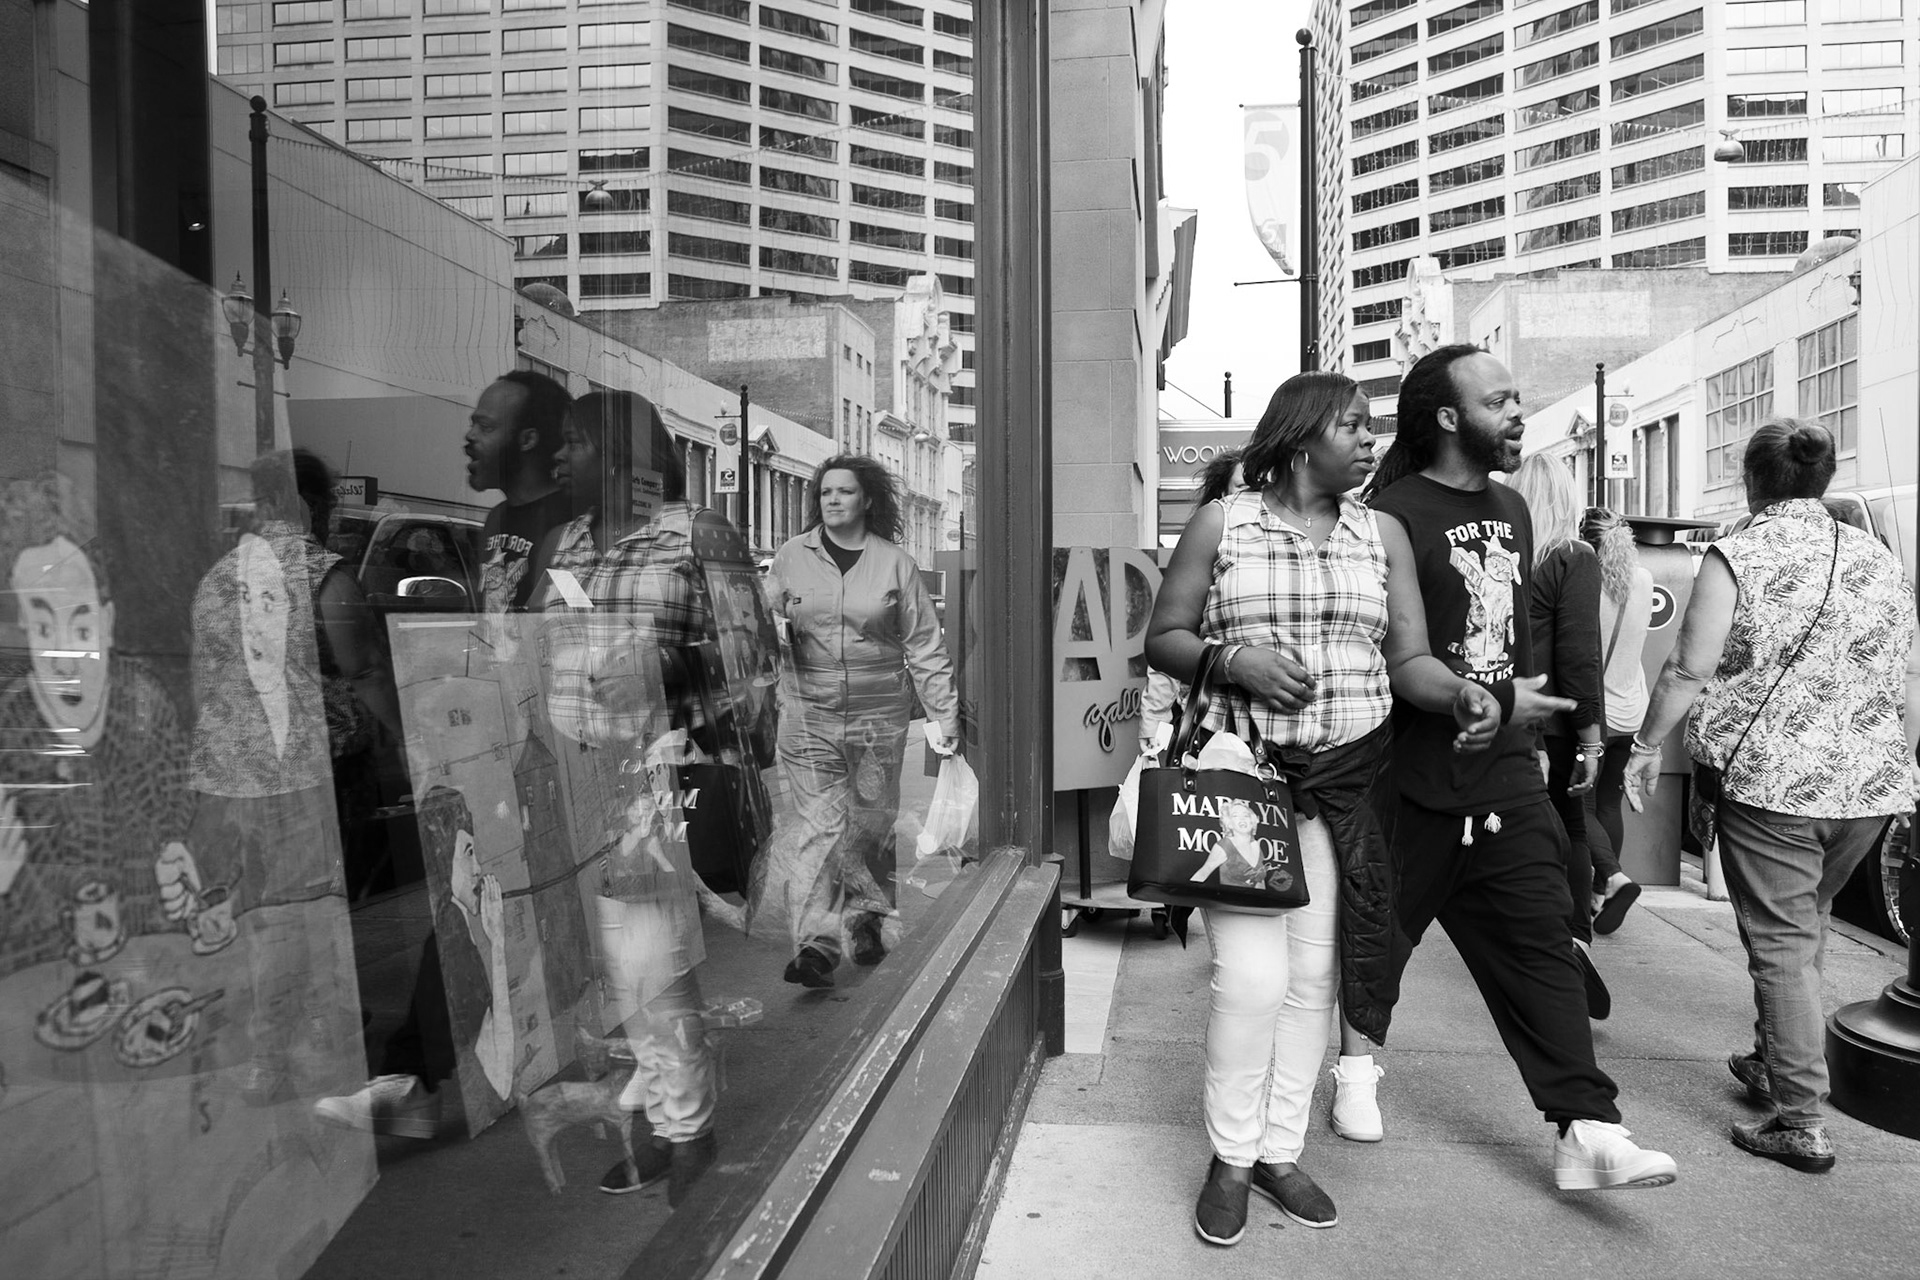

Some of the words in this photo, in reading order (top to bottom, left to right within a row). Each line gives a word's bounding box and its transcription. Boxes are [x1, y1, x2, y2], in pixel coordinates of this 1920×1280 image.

[1444, 522, 1482, 547] FOR
[1481, 520, 1513, 540] THE
[1084, 688, 1141, 752] gall
[1171, 792, 1289, 829] MAYN
[1177, 827, 1290, 864] MOOE
